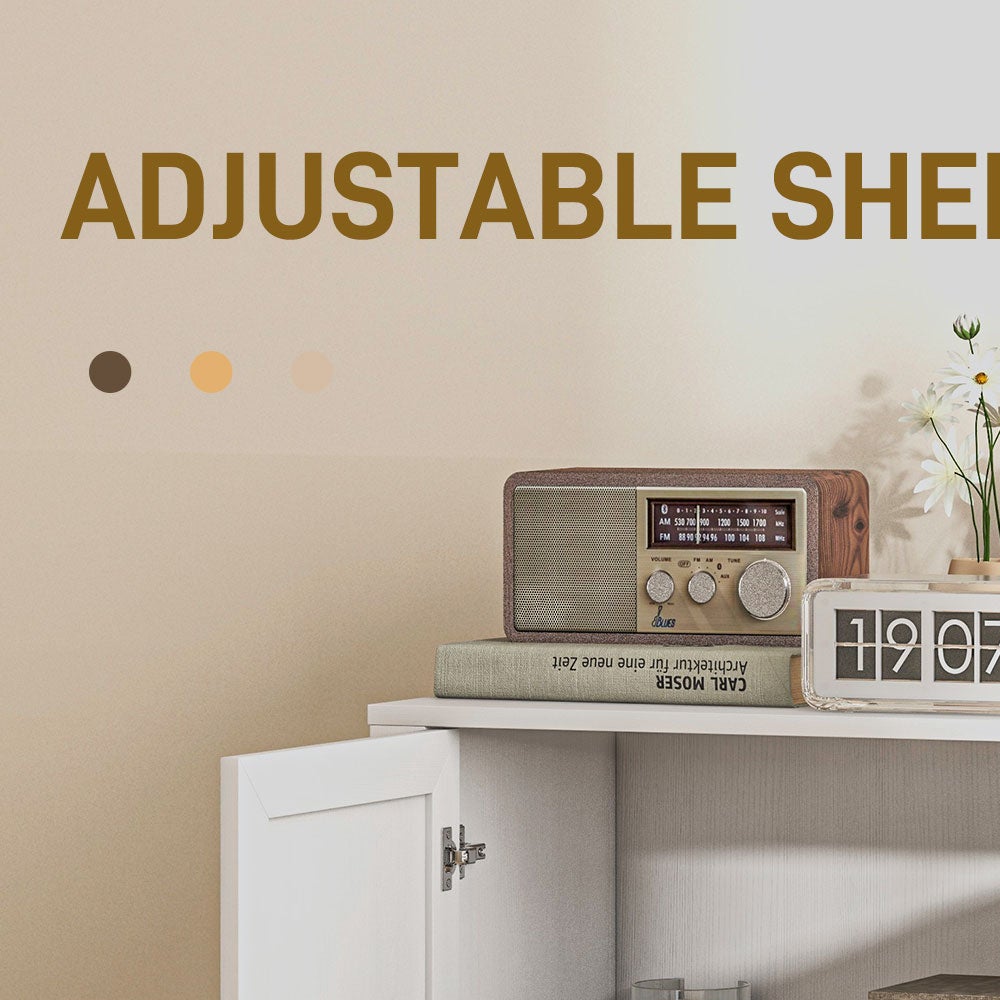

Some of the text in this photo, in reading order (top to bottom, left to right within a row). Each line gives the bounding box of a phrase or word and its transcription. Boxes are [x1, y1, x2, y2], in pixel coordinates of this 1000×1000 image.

[674, 518, 685, 526] 530
[686, 518, 696, 526] 700
[718, 518, 730, 526] 1200
[753, 519, 766, 527] 1700
[686, 533, 694, 541] 90
[710, 534, 718, 542] 96
[725, 534, 736, 542] 100
[740, 534, 749, 542] 104
[552, 656, 748, 675] Architektur für eine neue Zeit
[656, 675, 746, 692] CARL MOSER
